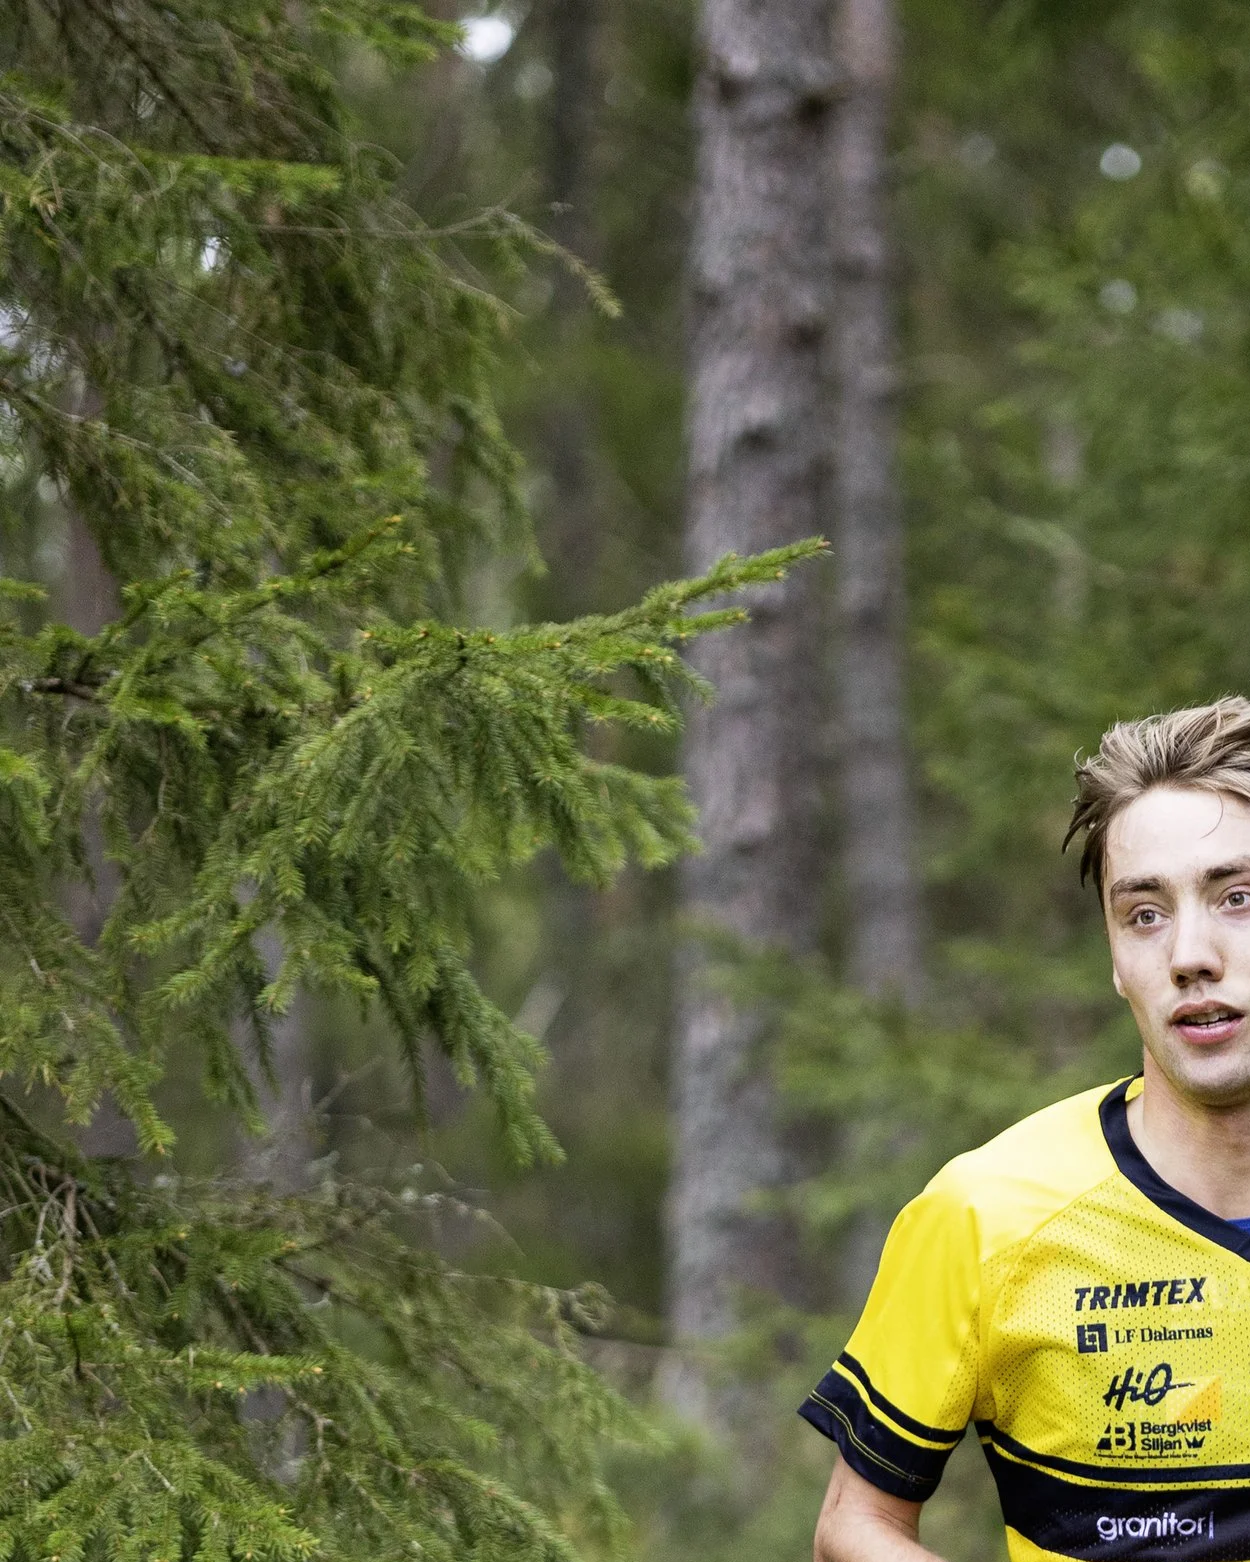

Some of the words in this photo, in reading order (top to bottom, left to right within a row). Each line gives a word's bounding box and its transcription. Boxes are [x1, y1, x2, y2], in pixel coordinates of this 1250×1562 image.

[1075, 1277, 1207, 1312] TRIMTEX
[1114, 1328, 1136, 1344] LF
[1140, 1325, 1213, 1343] Dalarnas
[1140, 1419, 1212, 1437] Bergkvist
[1140, 1437, 1182, 1456] Siljan
